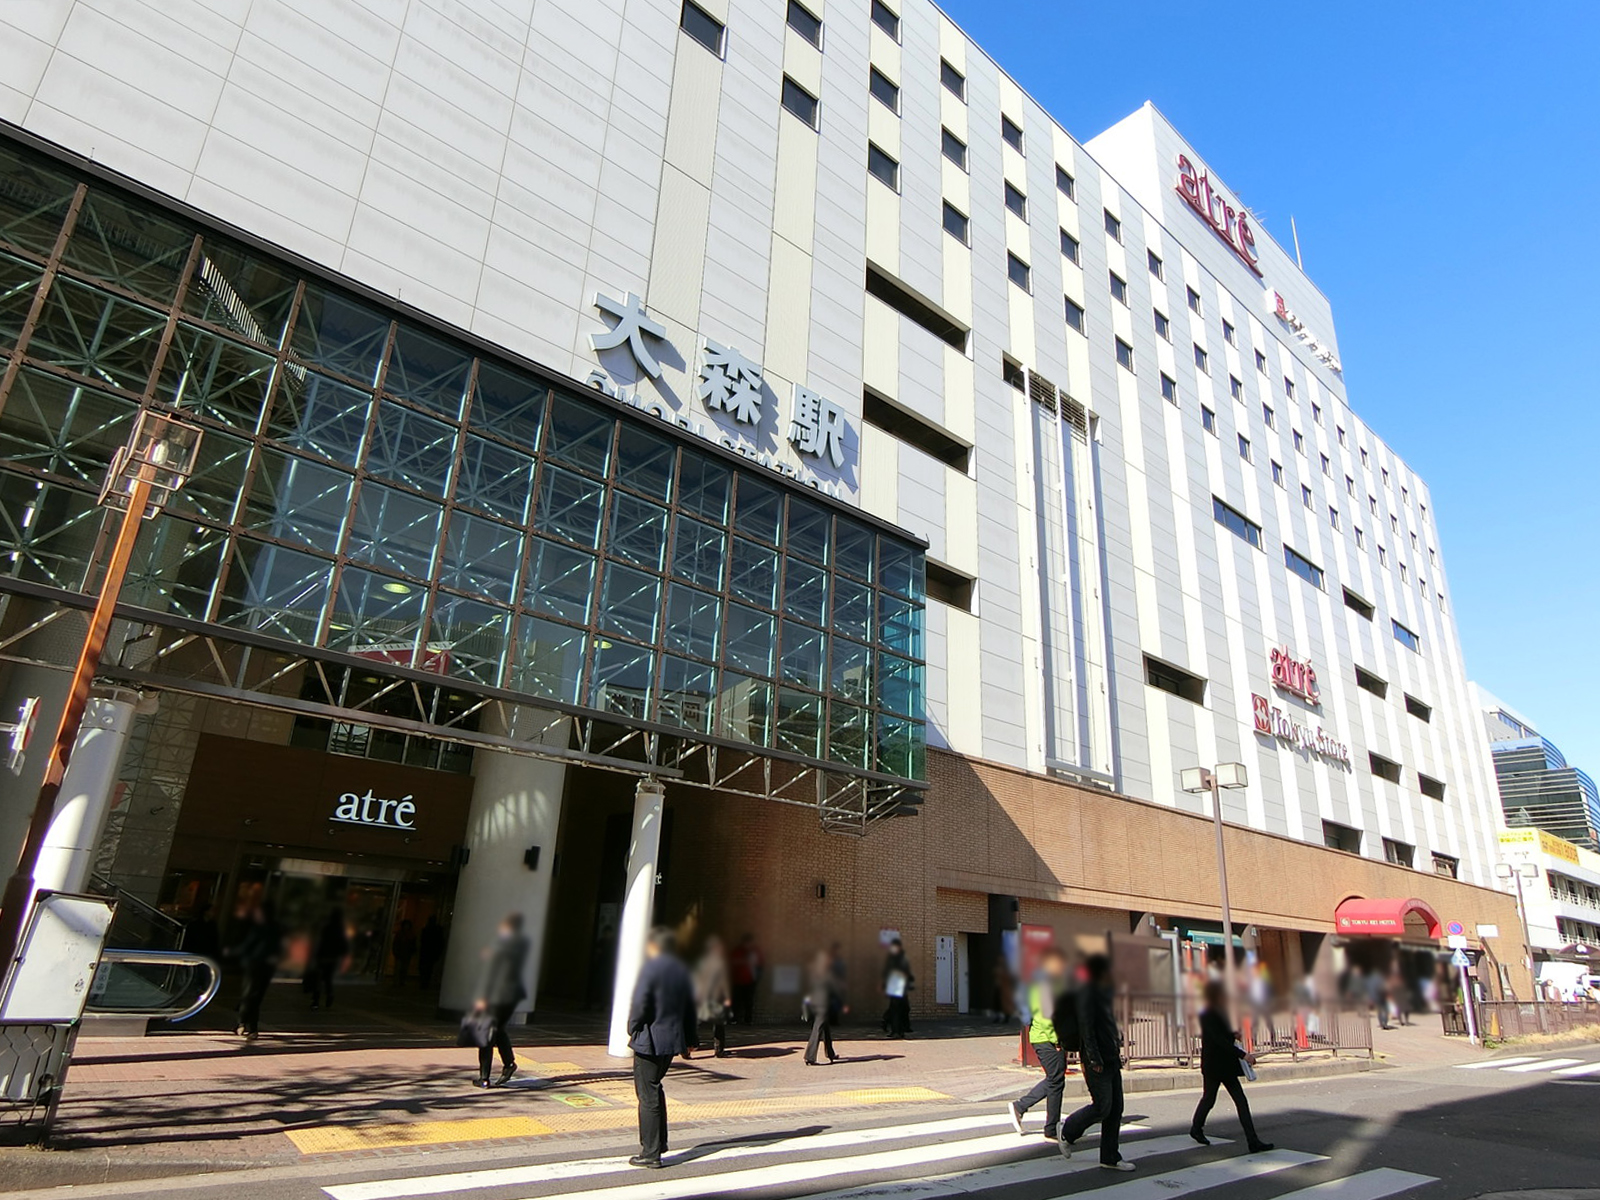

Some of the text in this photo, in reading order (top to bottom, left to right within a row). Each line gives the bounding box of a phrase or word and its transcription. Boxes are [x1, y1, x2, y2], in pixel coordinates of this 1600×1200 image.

[1175, 153, 1261, 270] atré
[587, 291, 846, 469] 大森駅
[1269, 644, 1321, 702] atré
[1271, 706, 1318, 750] Tokyu
[333, 788, 417, 828] atré
